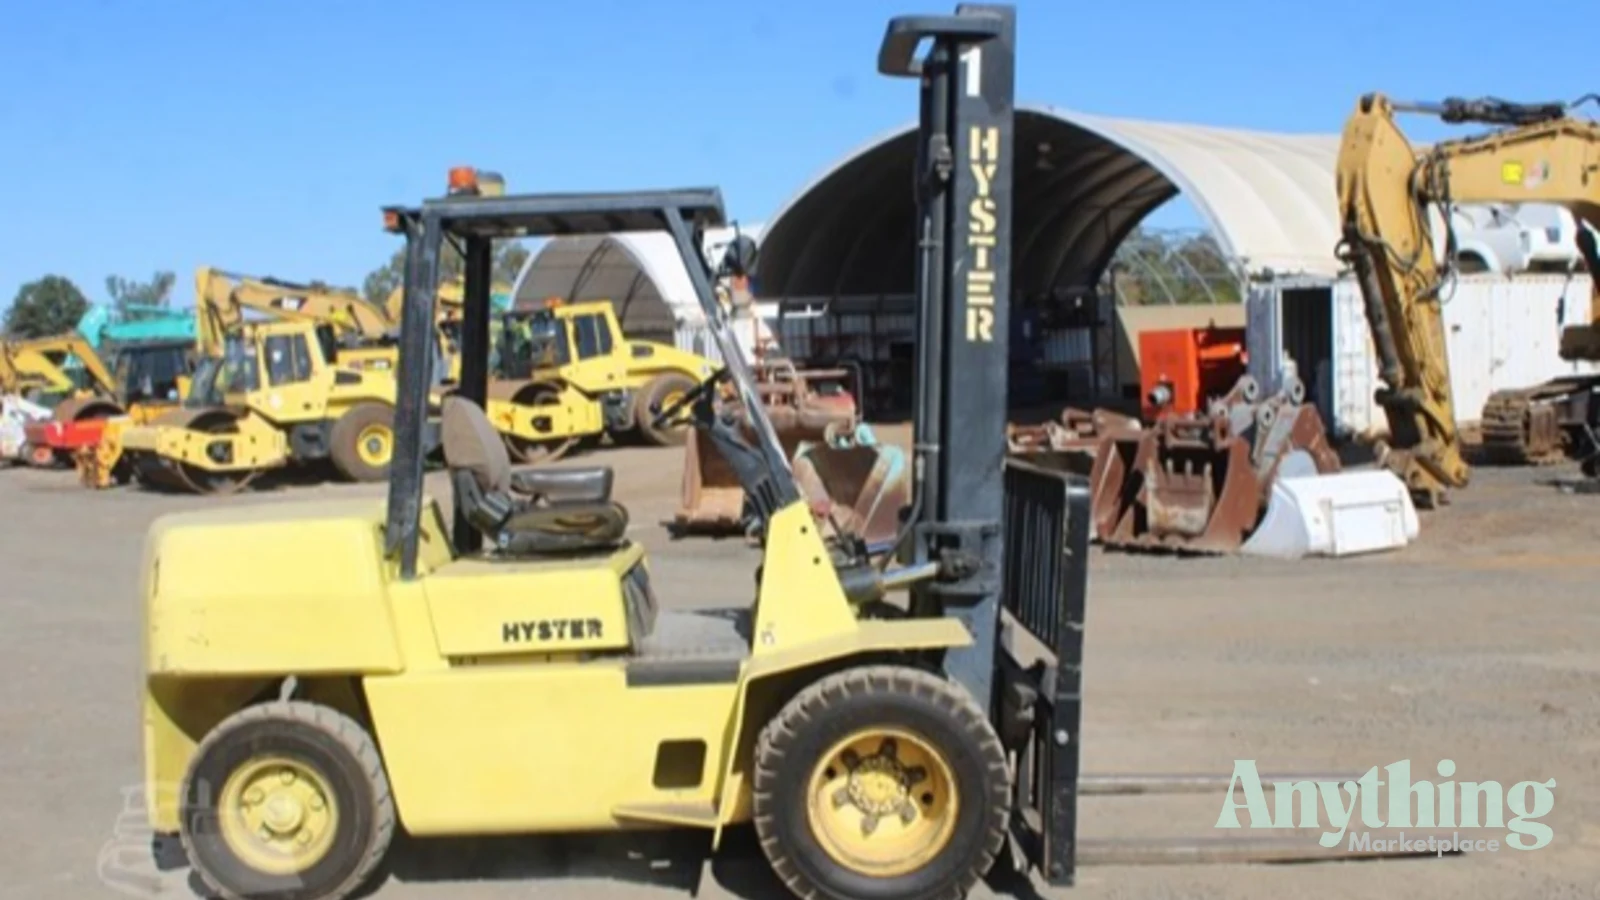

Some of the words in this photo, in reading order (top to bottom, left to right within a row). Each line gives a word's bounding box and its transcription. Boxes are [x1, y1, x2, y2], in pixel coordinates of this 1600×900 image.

[960, 47, 981, 97] 1
[966, 127, 998, 341] HYSTER
[502, 618, 603, 642] HYSTER
